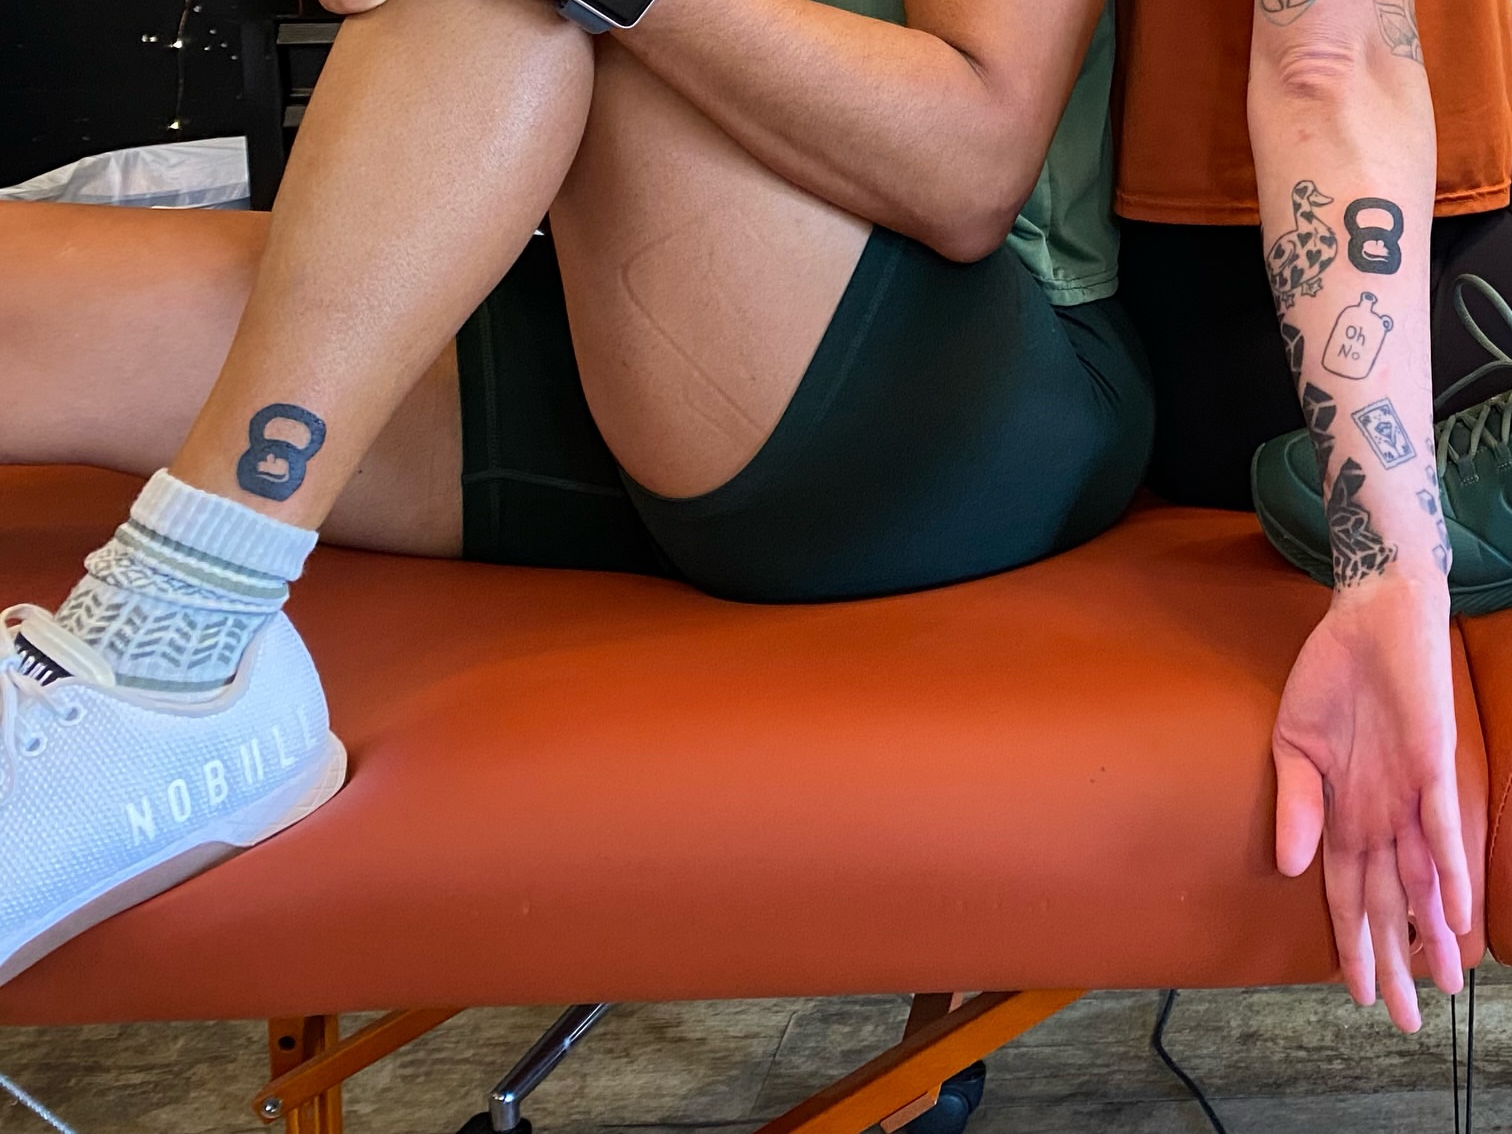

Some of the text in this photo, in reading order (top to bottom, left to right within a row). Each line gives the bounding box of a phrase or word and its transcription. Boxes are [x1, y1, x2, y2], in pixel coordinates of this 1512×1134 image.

[1345, 325, 1366, 347] Oh
[1337, 343, 1361, 361] No
[125, 705, 318, 846] NOBULL
